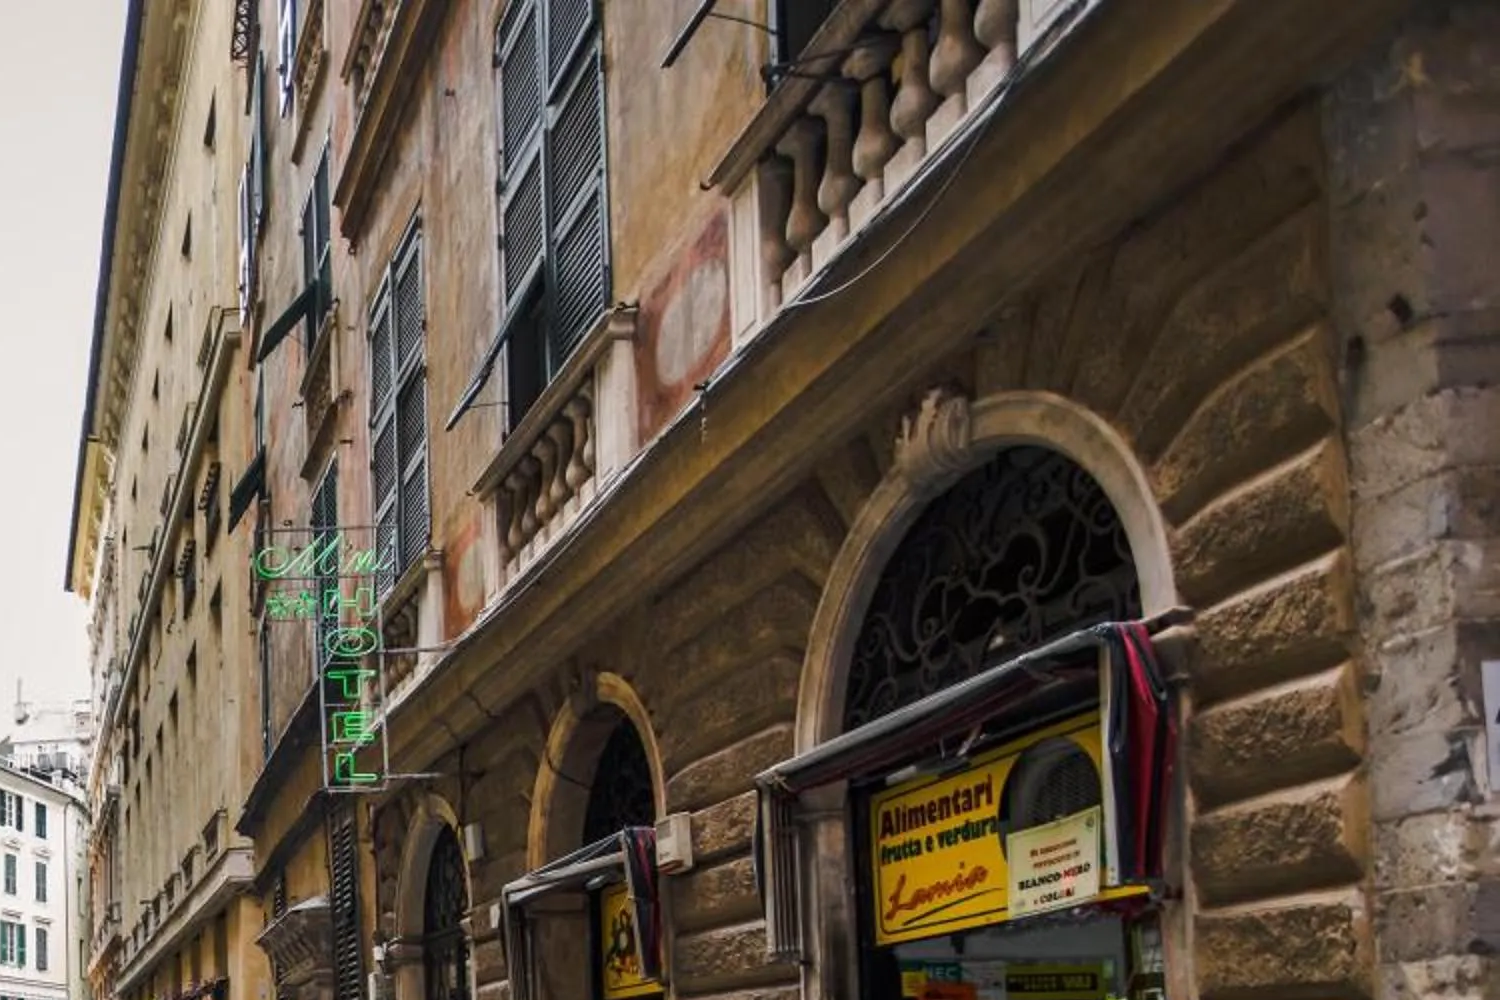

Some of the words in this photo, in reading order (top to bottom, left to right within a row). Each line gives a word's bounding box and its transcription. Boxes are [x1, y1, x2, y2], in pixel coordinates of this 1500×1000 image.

[323, 586, 378, 783] HOTEL
[880, 774, 993, 839] Alimentari
[925, 835, 933, 853] e
[937, 816, 997, 848] verdura
